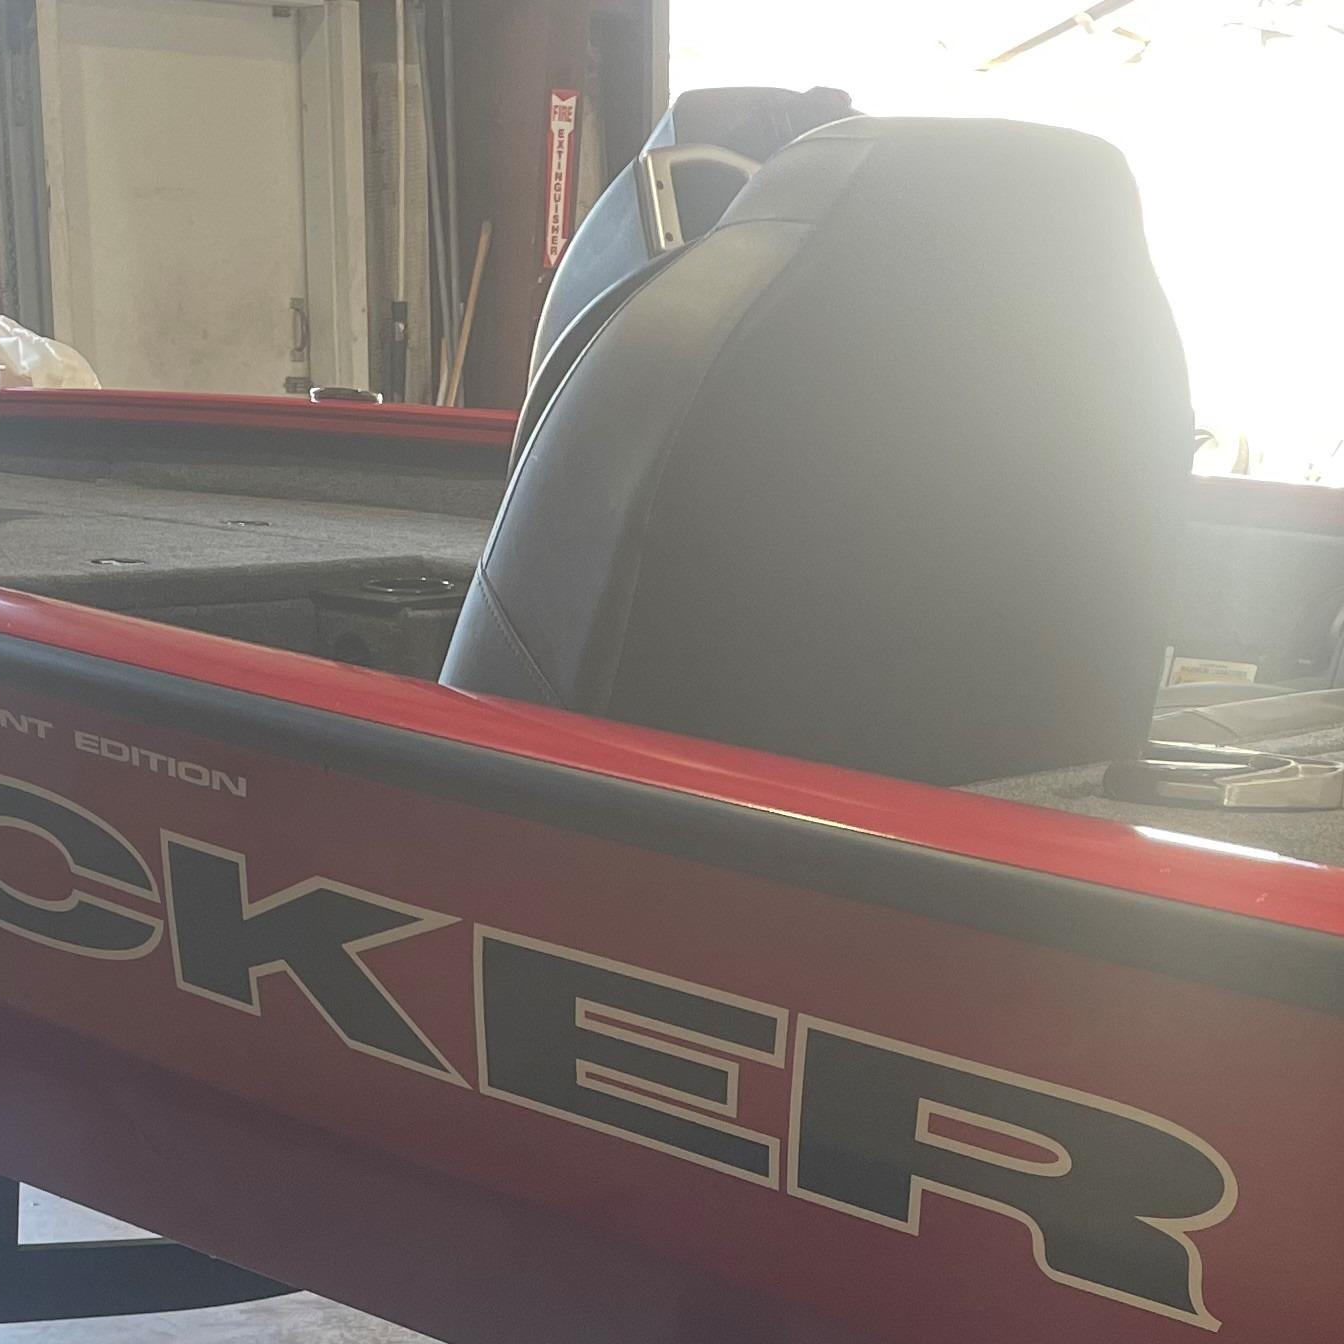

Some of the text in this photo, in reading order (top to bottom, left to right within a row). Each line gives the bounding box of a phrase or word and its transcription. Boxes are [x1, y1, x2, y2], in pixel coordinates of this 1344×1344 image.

[552, 105, 573, 122] FIRE
[550, 128, 565, 256] EXTINGUISHER
[74, 729, 247, 797] EDITION
